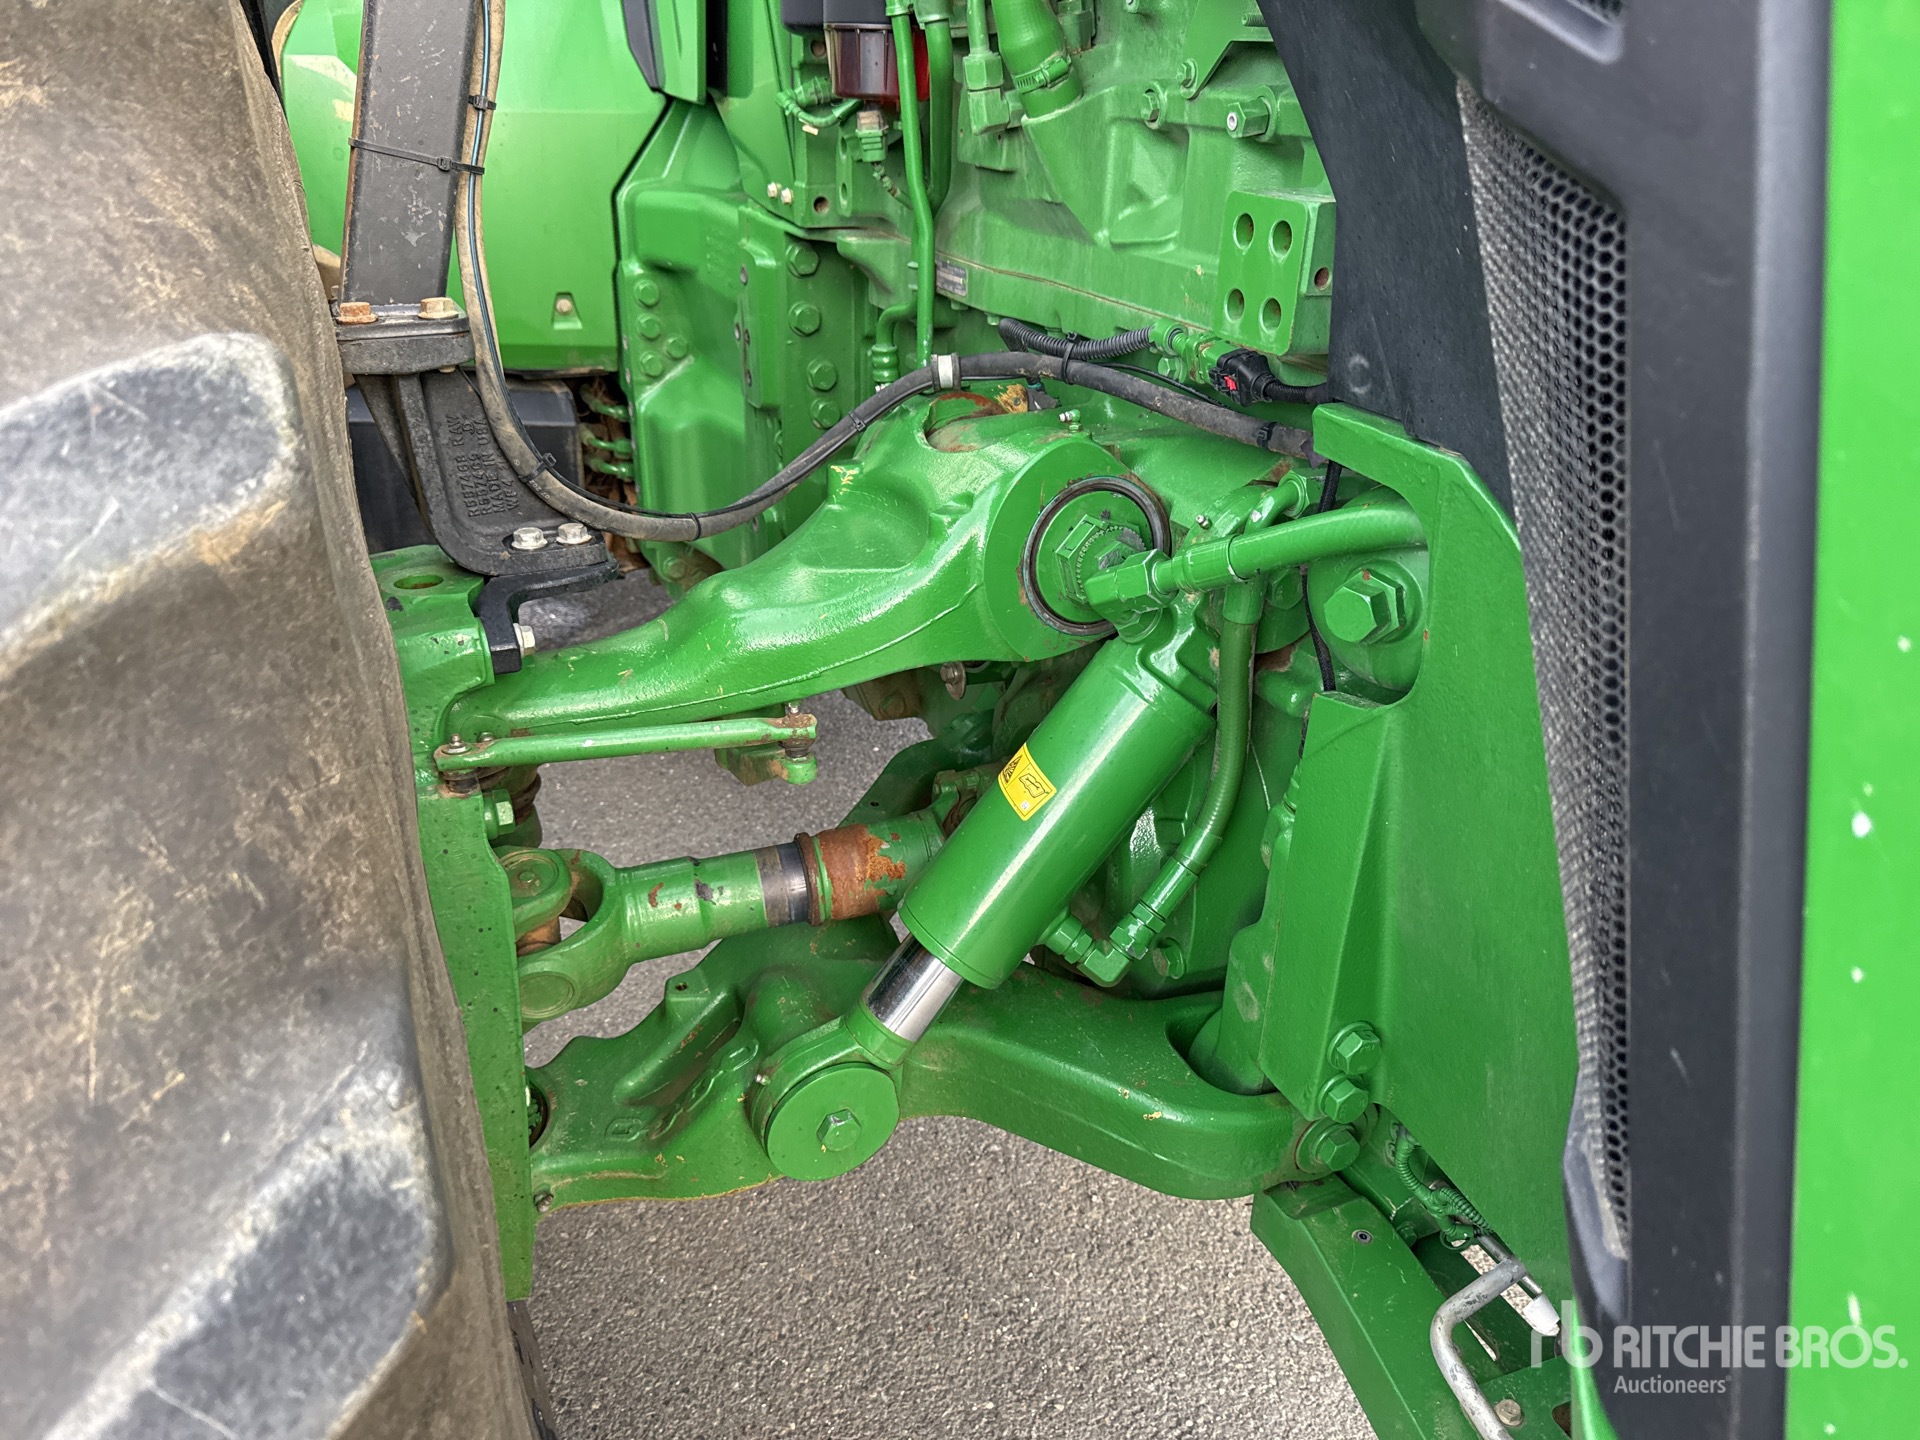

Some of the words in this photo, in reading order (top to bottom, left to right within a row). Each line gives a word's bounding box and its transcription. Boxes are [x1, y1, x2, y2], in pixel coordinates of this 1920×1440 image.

[446, 414, 464, 447] RAW
[474, 416, 490, 446] USA
[482, 452, 495, 467] IN
[486, 471, 506, 514] MADE
